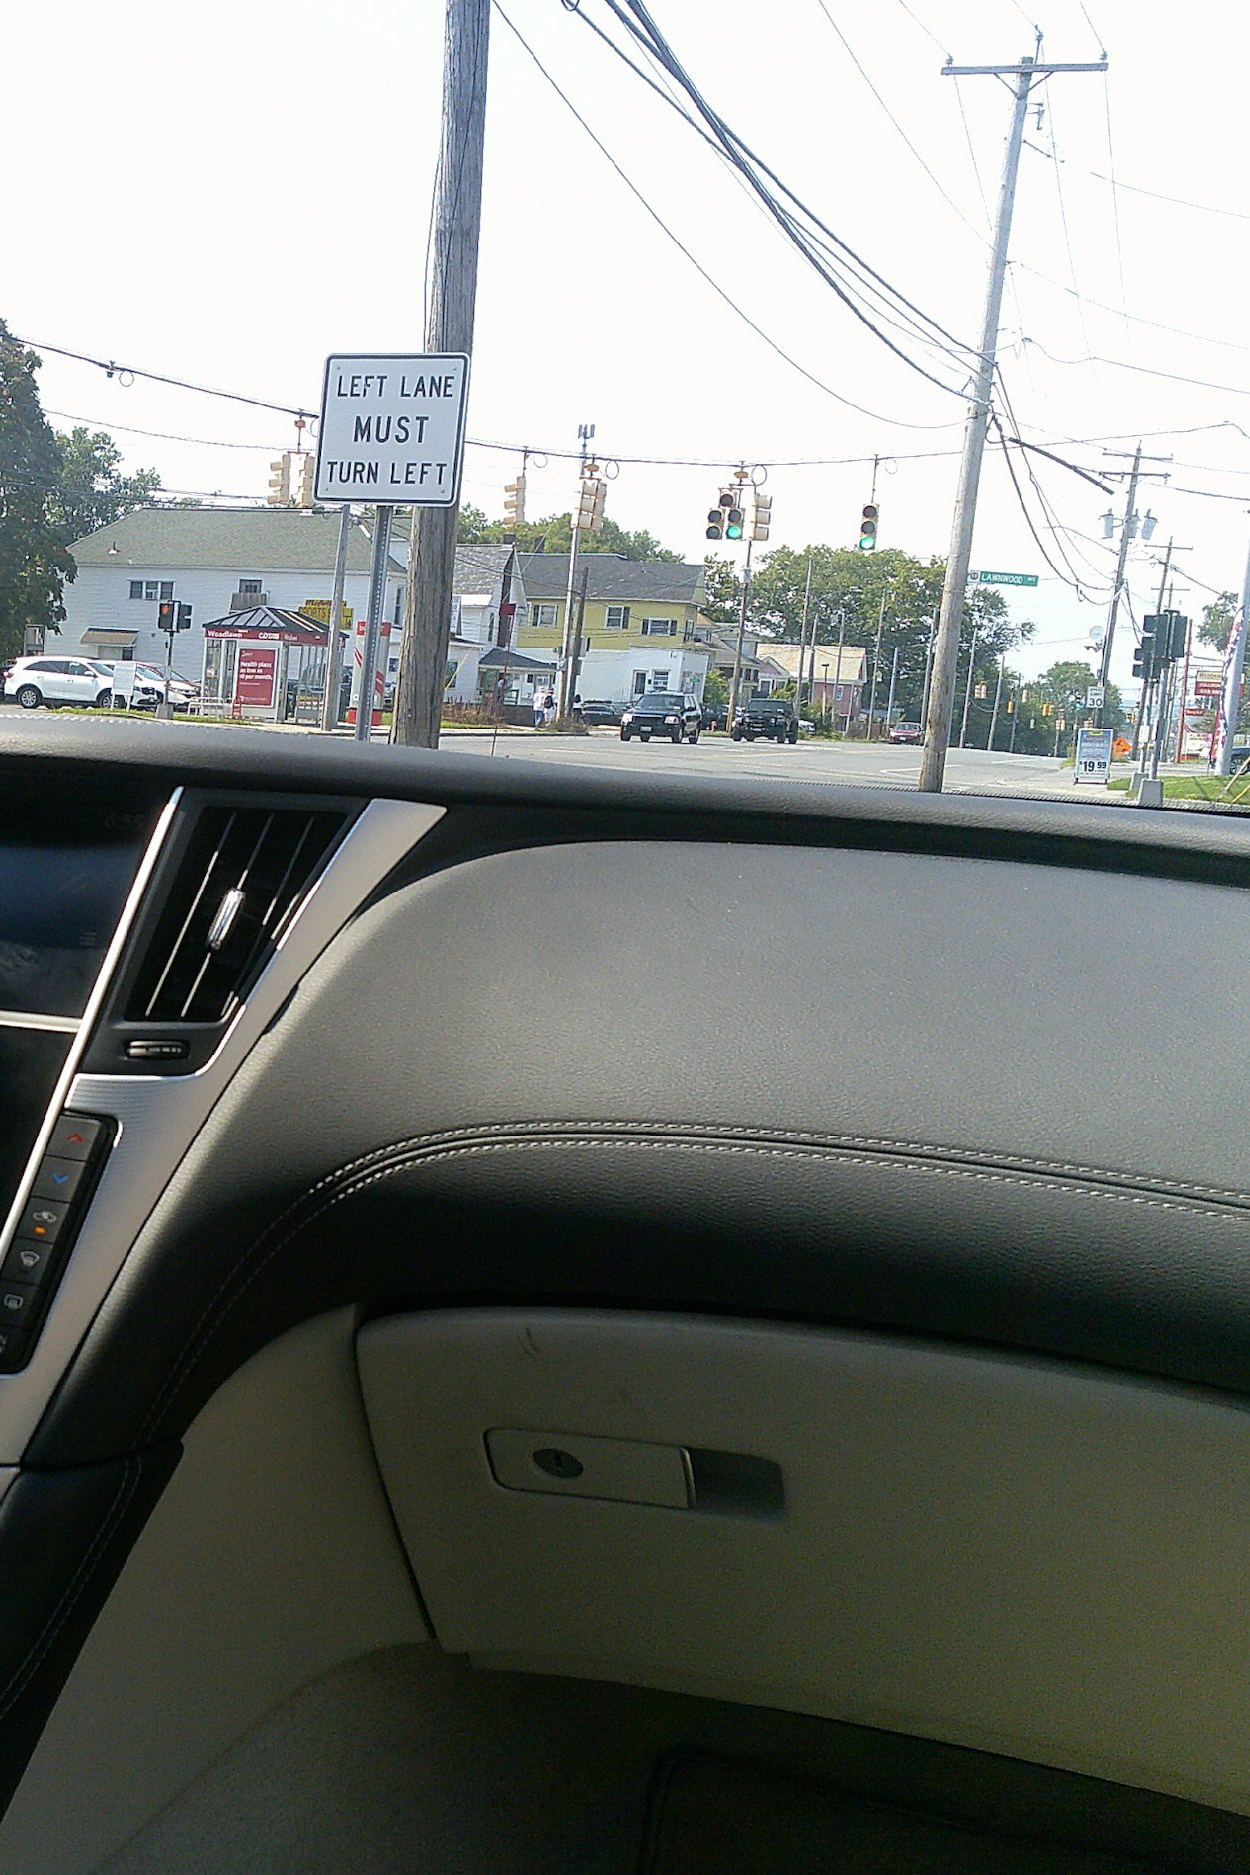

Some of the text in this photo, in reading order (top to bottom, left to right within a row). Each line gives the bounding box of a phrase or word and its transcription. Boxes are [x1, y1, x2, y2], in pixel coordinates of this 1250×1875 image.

[337, 375, 455, 398] LEFT LANE
[353, 415, 429, 444] MUST
[327, 461, 447, 485] TURN LEFT
[981, 573, 1023, 584] LAWNWOOD
[1088, 697, 1103, 707] 30
